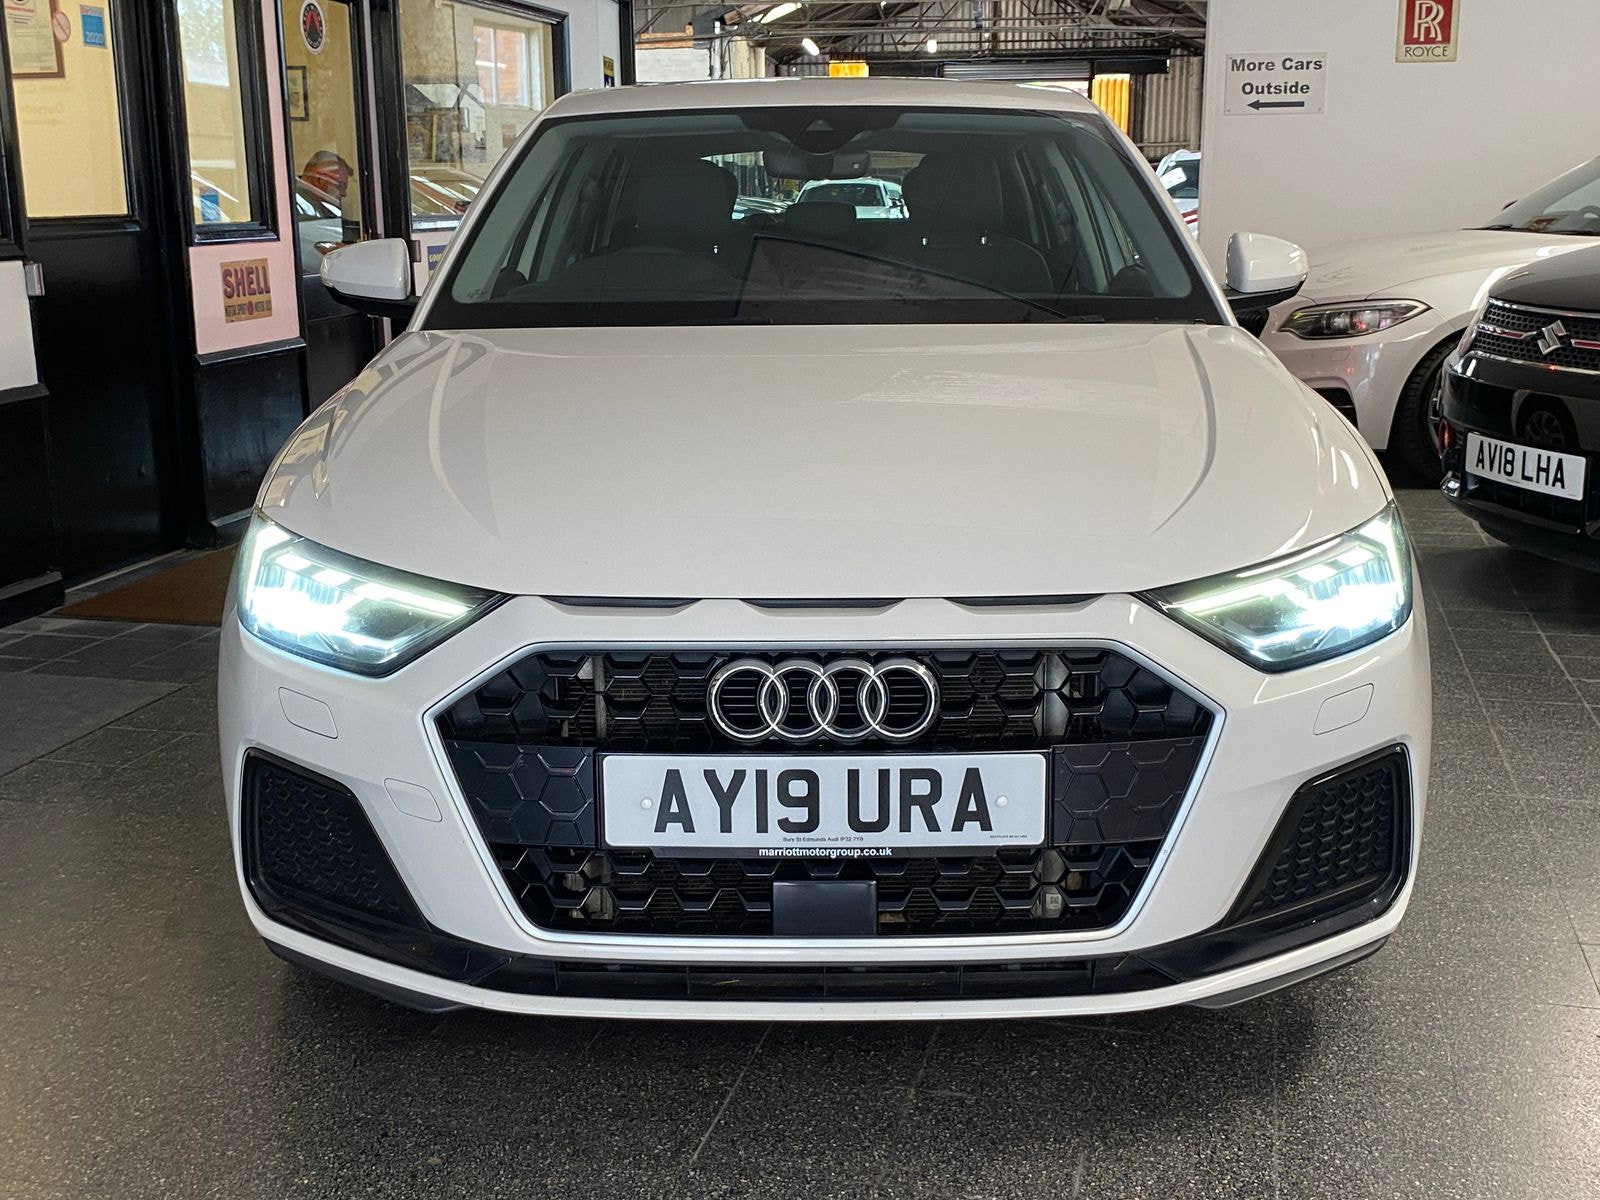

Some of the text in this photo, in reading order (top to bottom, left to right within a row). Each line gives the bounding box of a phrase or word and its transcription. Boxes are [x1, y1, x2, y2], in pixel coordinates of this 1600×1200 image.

[85, 31, 104, 44] 2020
[1404, 46, 1448, 57] ROYCE
[1231, 58, 1323, 72] More Cars
[1241, 81, 1310, 95] Outside
[222, 265, 271, 299] SHELL
[1476, 440, 1566, 489] AV18 LHA
[653, 767, 993, 833] AY19 URA
[759, 848, 892, 858] marriottmotorgroup.co.uk
